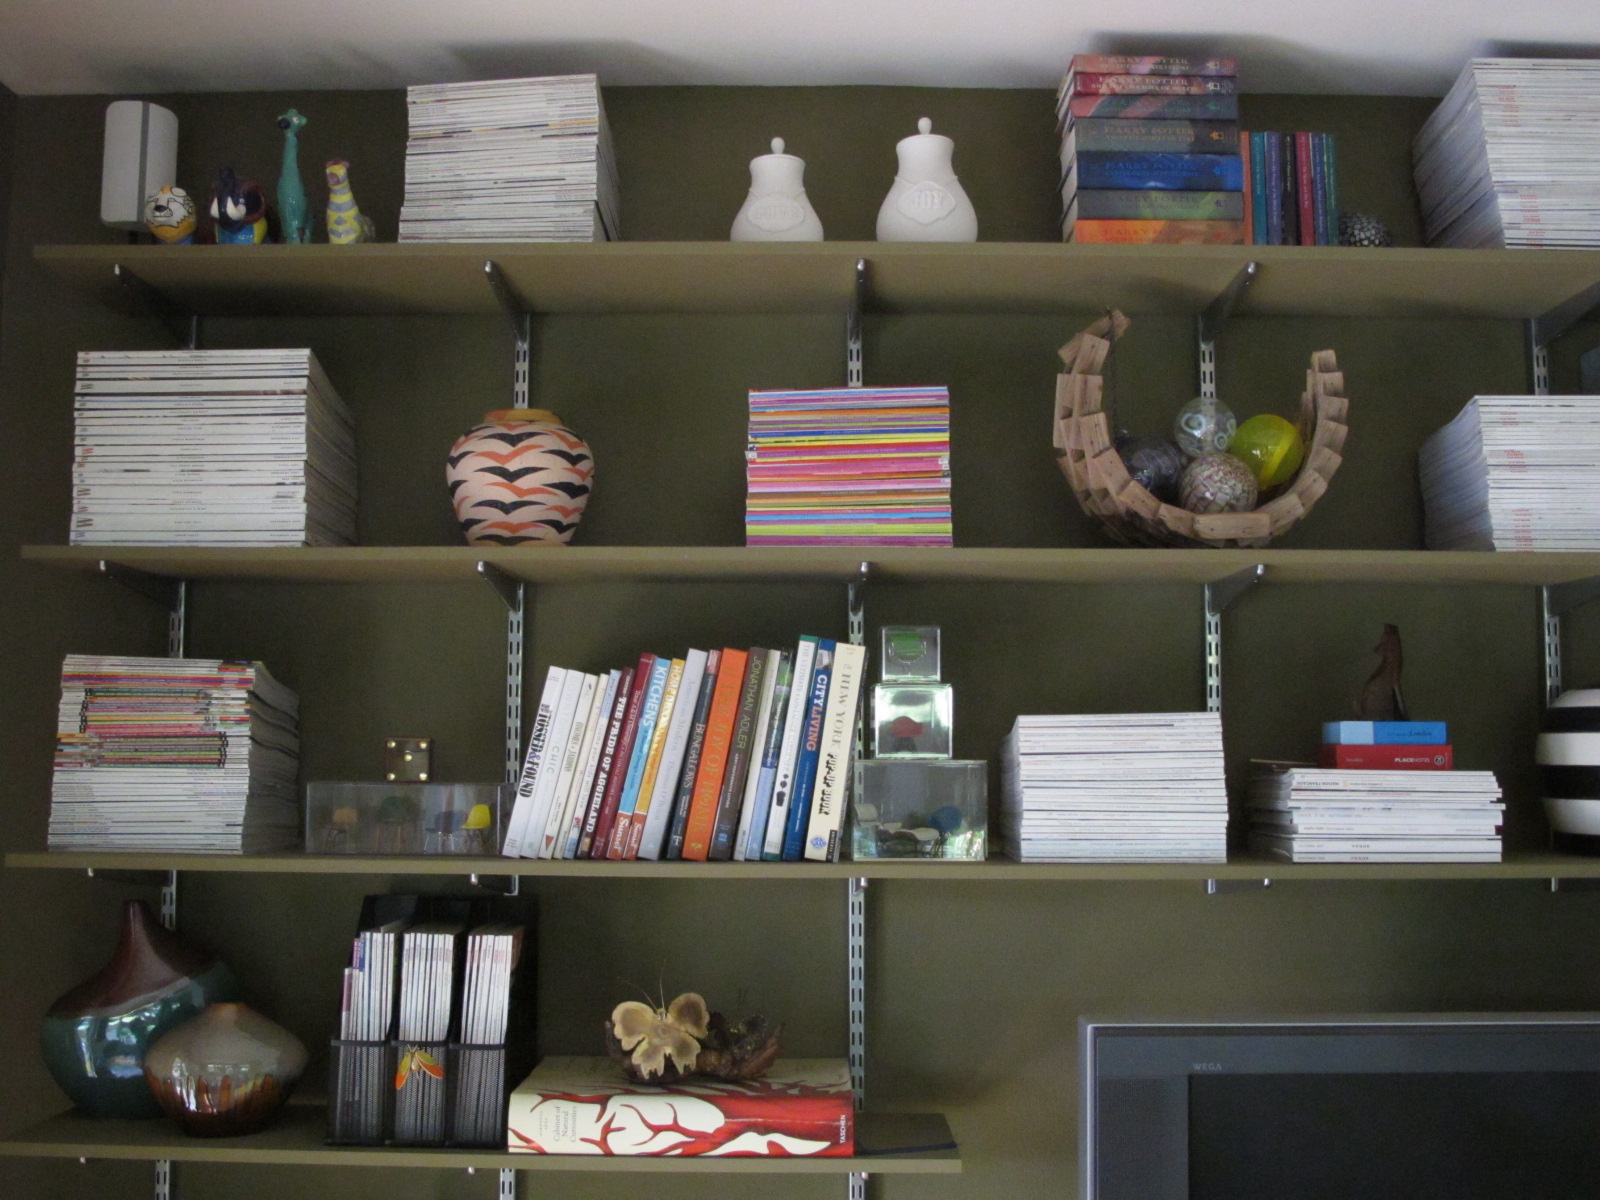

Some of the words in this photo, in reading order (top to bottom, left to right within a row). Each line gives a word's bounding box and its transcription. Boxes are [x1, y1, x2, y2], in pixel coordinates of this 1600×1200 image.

[667, 664, 681, 694] HOME
[744, 655, 762, 711] JONATHAN
[837, 673, 851, 707] NEW
[614, 696, 626, 719] THE
[642, 665, 667, 727] KITCHENS
[605, 720, 620, 754] PRIDE
[709, 719, 727, 751] JOY
[736, 714, 750, 749] ADLER
[830, 710, 845, 748] YORK
[546, 745, 560, 774] CHIC
[601, 756, 611, 770] OF
[682, 722, 705, 789] BUNGALOWS
[702, 753, 721, 777] OF
[822, 752, 838, 788] POP-UP
[579, 793, 587, 808] love
[585, 771, 607, 833] AGGIELAND
[818, 788, 833, 815] BOOK
[612, 816, 629, 850] Sunset
[629, 822, 642, 847] Sunset
[554, 1105, 561, 1113] of
[569, 1105, 577, 1143] Curiosities
[553, 1114, 561, 1141] Cabinet
[839, 1114, 847, 1143] TASCHEN
